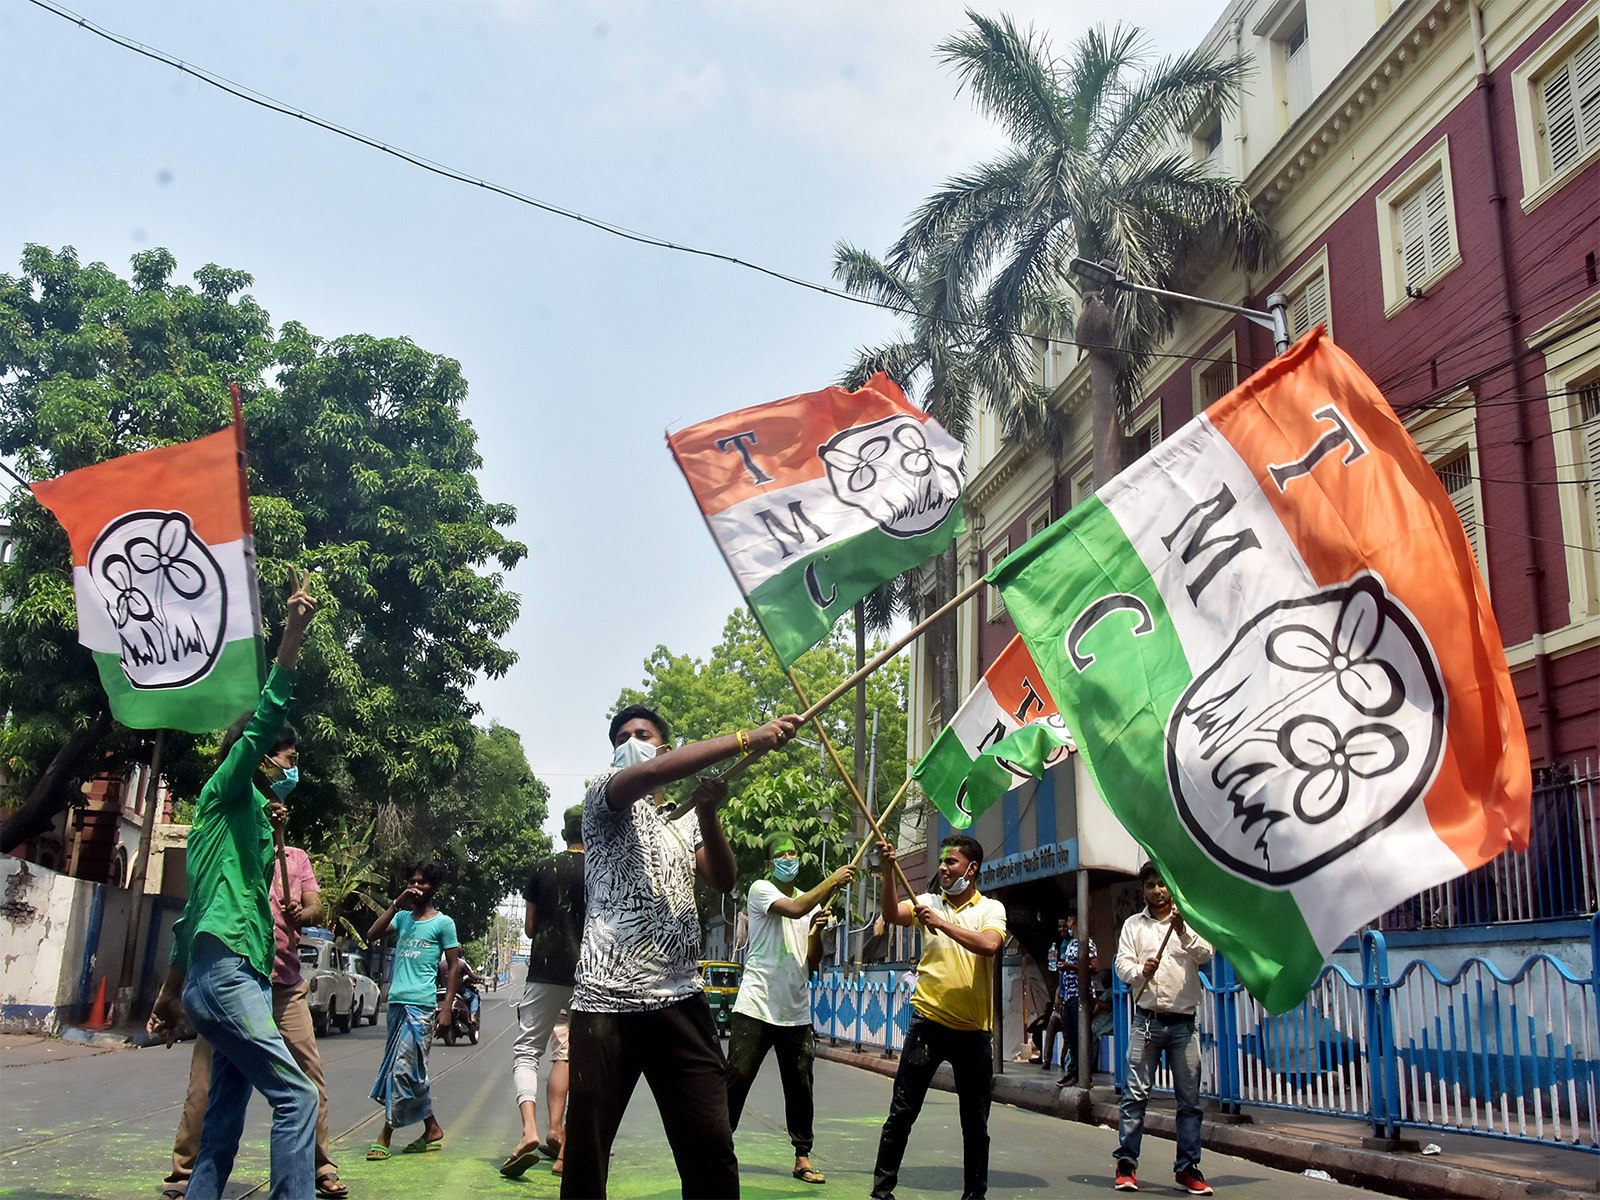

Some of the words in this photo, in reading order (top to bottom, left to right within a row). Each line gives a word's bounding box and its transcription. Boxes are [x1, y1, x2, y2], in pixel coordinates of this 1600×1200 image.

[715, 430, 775, 486] T
[1266, 402, 1370, 494] T
[755, 500, 832, 559] M
[1160, 482, 1262, 608] M
[804, 555, 839, 609] C
[1064, 593, 1155, 674] C
[1013, 676, 1045, 725] T
